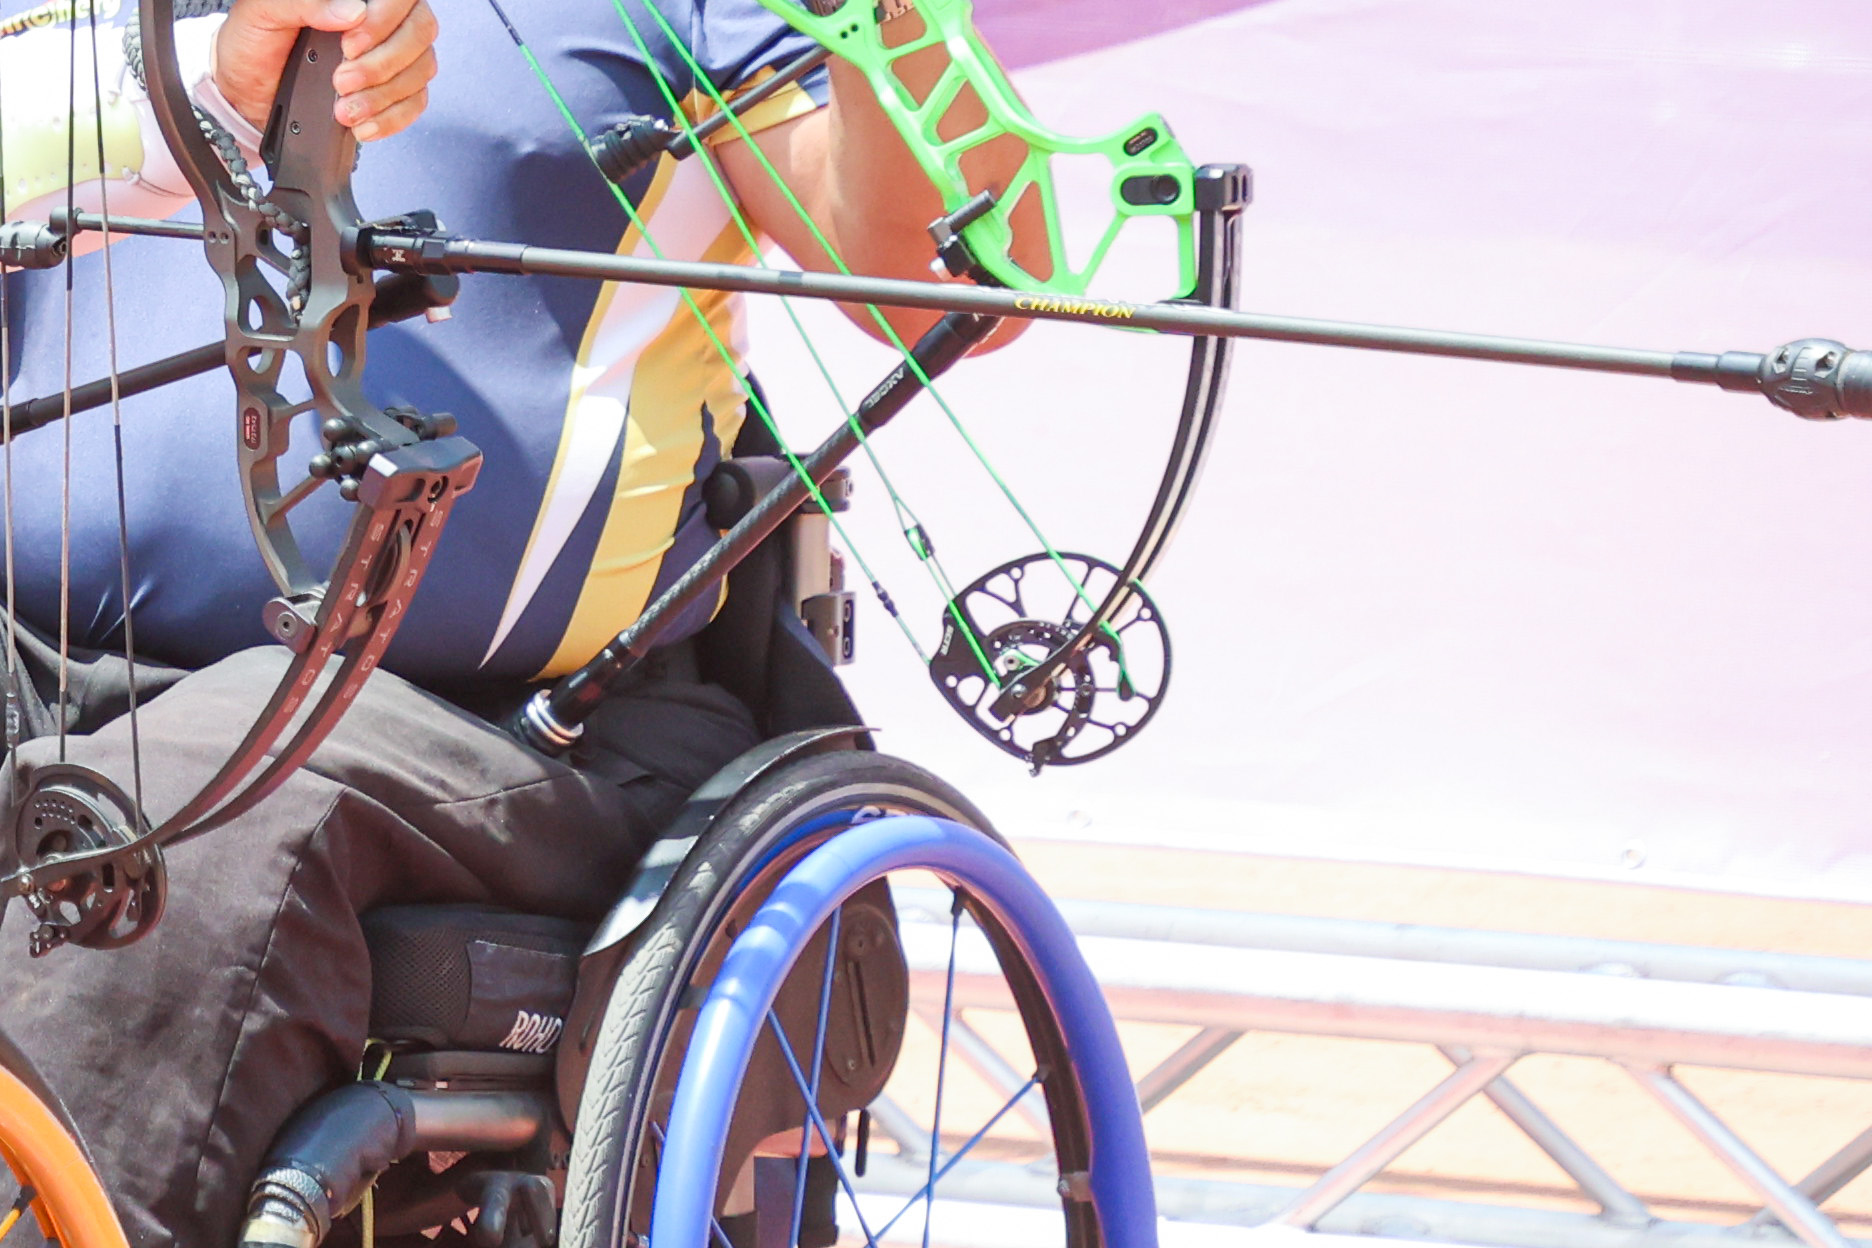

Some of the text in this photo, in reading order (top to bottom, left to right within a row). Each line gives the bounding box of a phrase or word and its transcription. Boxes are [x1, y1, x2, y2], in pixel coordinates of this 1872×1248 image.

[1013, 296, 1137, 319] CHAMPION
[283, 522, 385, 714] STRATOS
[342, 509, 445, 700] STRATOS
[499, 1010, 563, 1054] ROHO
